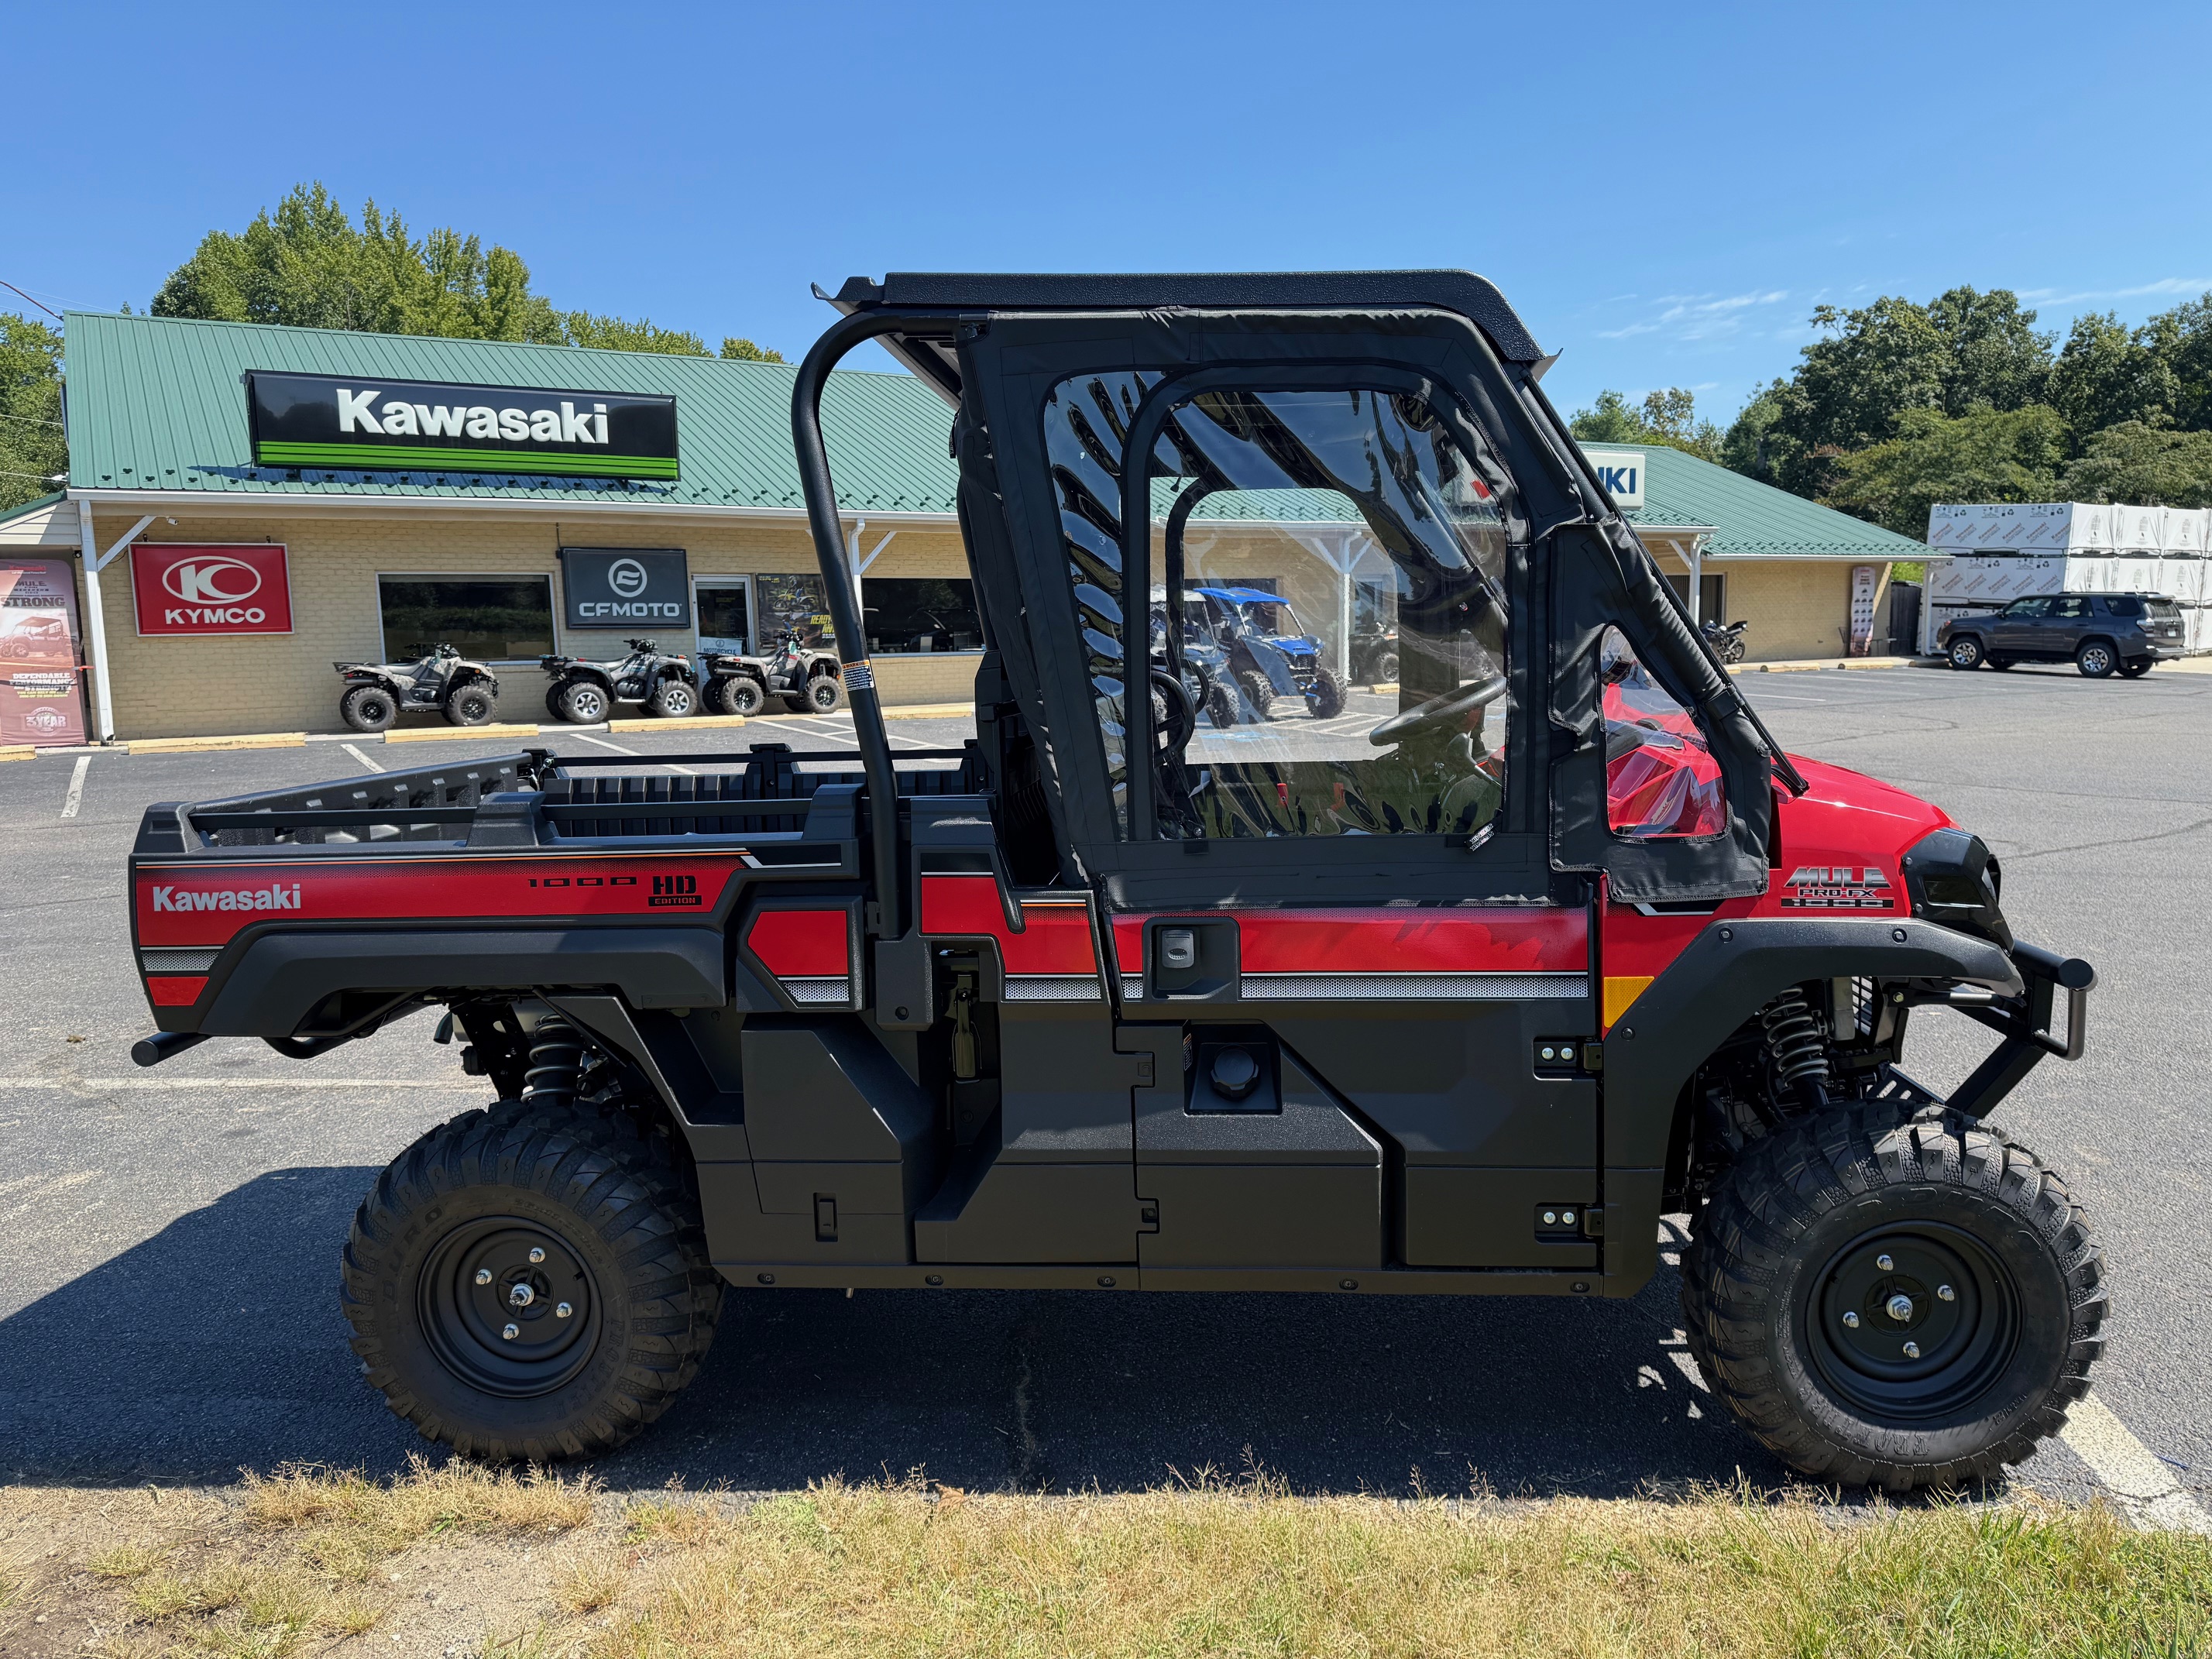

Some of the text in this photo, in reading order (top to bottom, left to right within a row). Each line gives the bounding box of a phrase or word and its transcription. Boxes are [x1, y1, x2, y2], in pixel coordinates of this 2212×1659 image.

[336, 388, 609, 445] Kawasaki
[1598, 466, 1637, 494] KI
[0, 596, 65, 608] STRONG
[579, 603, 680, 617] CFMOTO
[165, 607, 266, 624] KYMCO
[527, 876, 637, 888] 1000
[652, 875, 697, 895] HD
[1784, 866, 1893, 889] MULE
[153, 884, 301, 912] Kawasaki
[1798, 888, 1877, 898] PRO-FX
[1792, 898, 1884, 908] 1000
